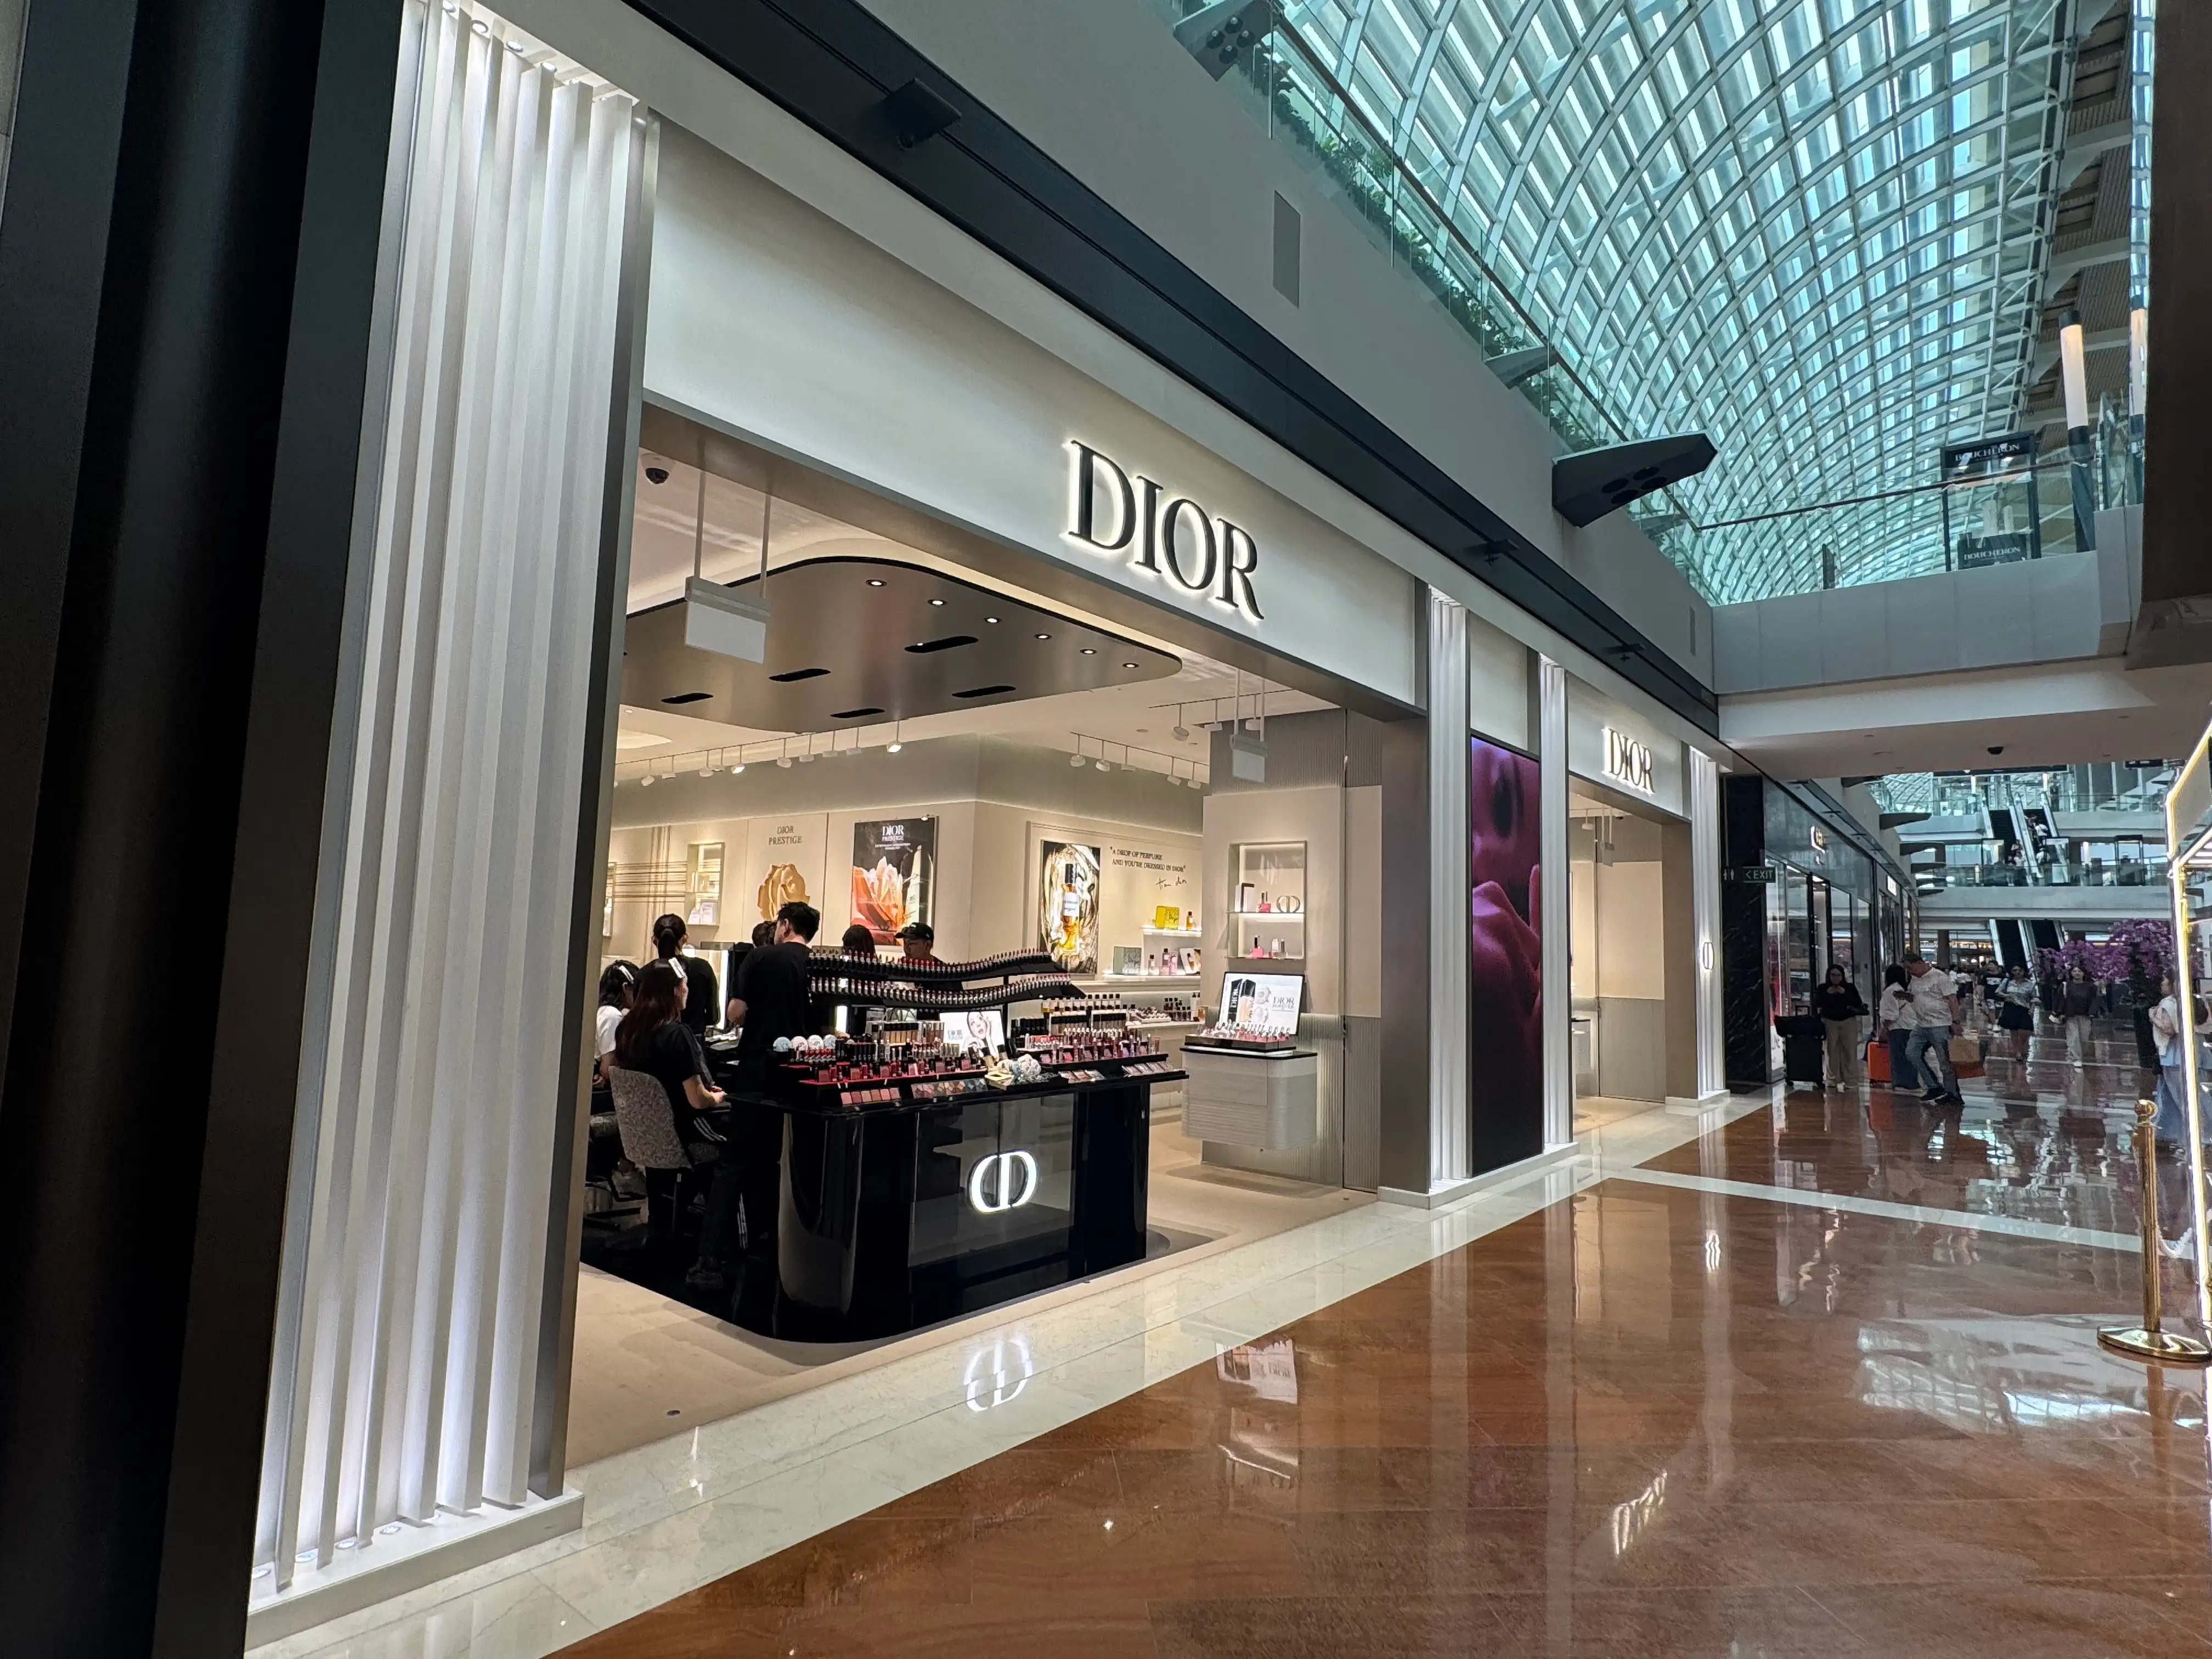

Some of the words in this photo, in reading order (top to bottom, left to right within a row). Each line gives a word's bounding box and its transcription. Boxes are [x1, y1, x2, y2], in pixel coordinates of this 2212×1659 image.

[1955, 443, 2020, 462] BUCHERON
[1068, 440, 1265, 620] DIOR
[1607, 727, 1656, 794] DIOR
[777, 825, 794, 834] DIOR
[882, 825, 904, 836] DIOR
[769, 836, 802, 845] PRESTIGE
[1139, 852, 1163, 861] PERFUME
[1143, 862, 1165, 871] DRESSED
[1753, 870, 1774, 880] EXIT
[1273, 996, 1295, 1005] DIOR
